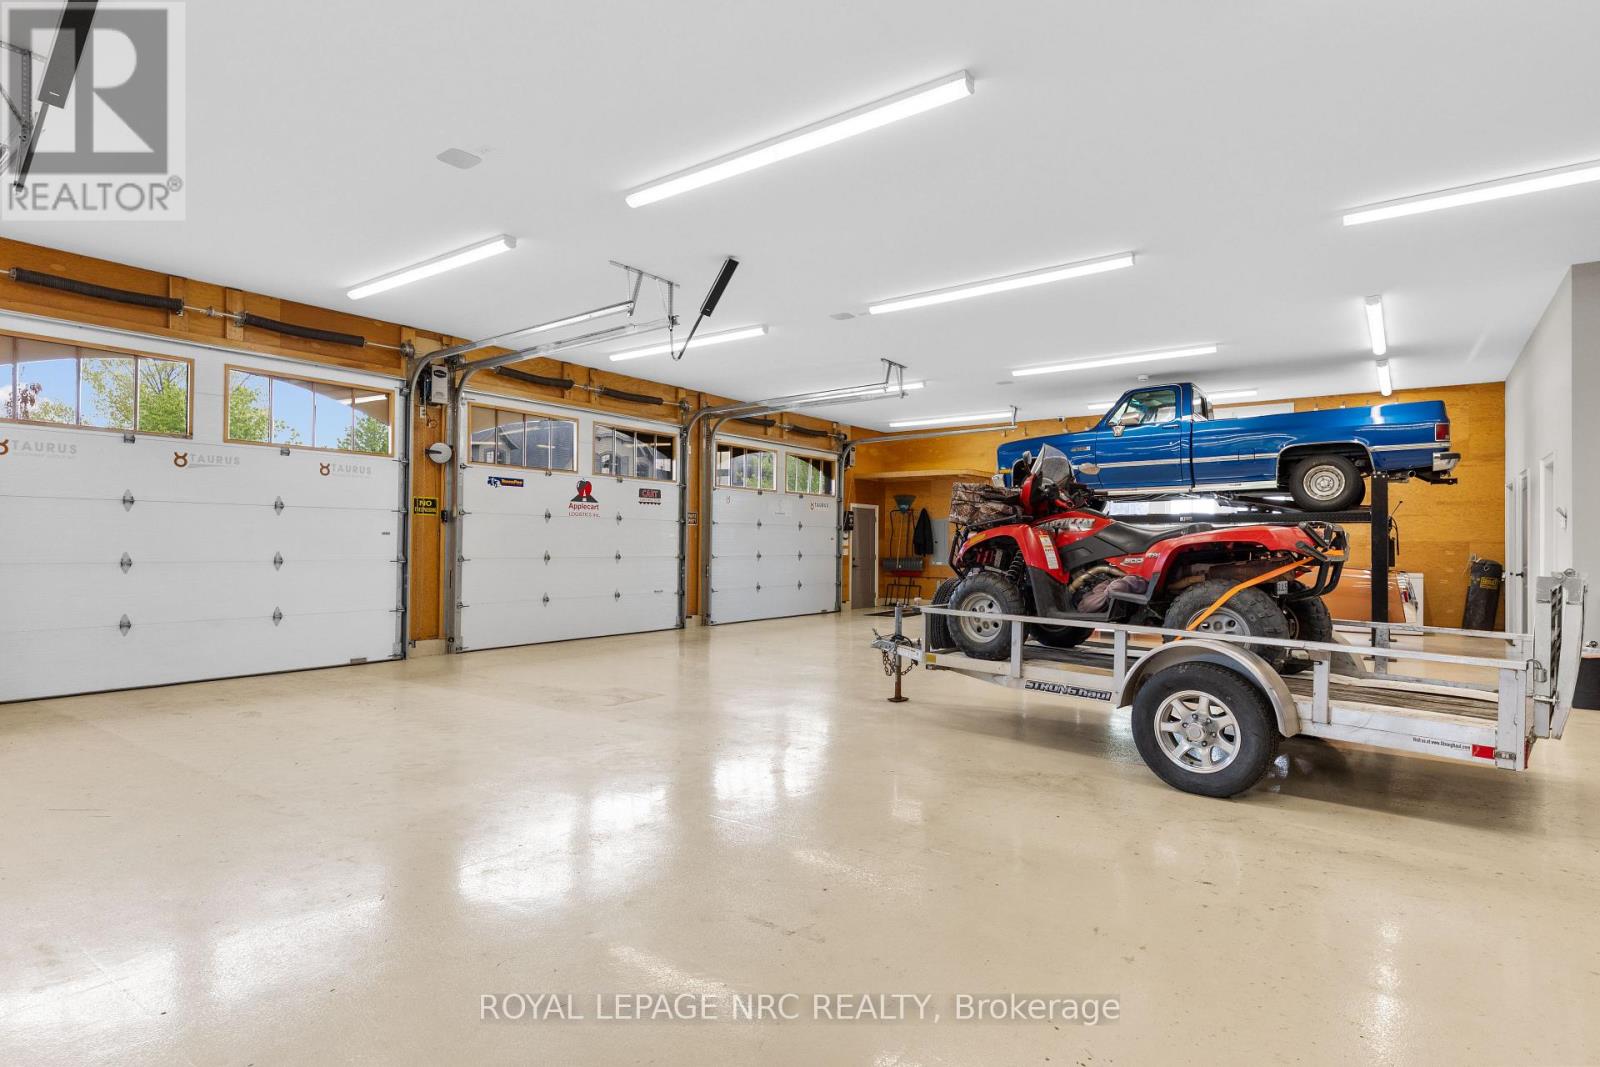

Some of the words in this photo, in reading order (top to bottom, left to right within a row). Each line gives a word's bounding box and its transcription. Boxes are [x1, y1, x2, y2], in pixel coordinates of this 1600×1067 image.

[11, 440, 77, 454] TAURUS
[190, 454, 240, 465] TAURUS
[331, 463, 372, 475] TAURUS
[568, 502, 599, 510] Applecart
